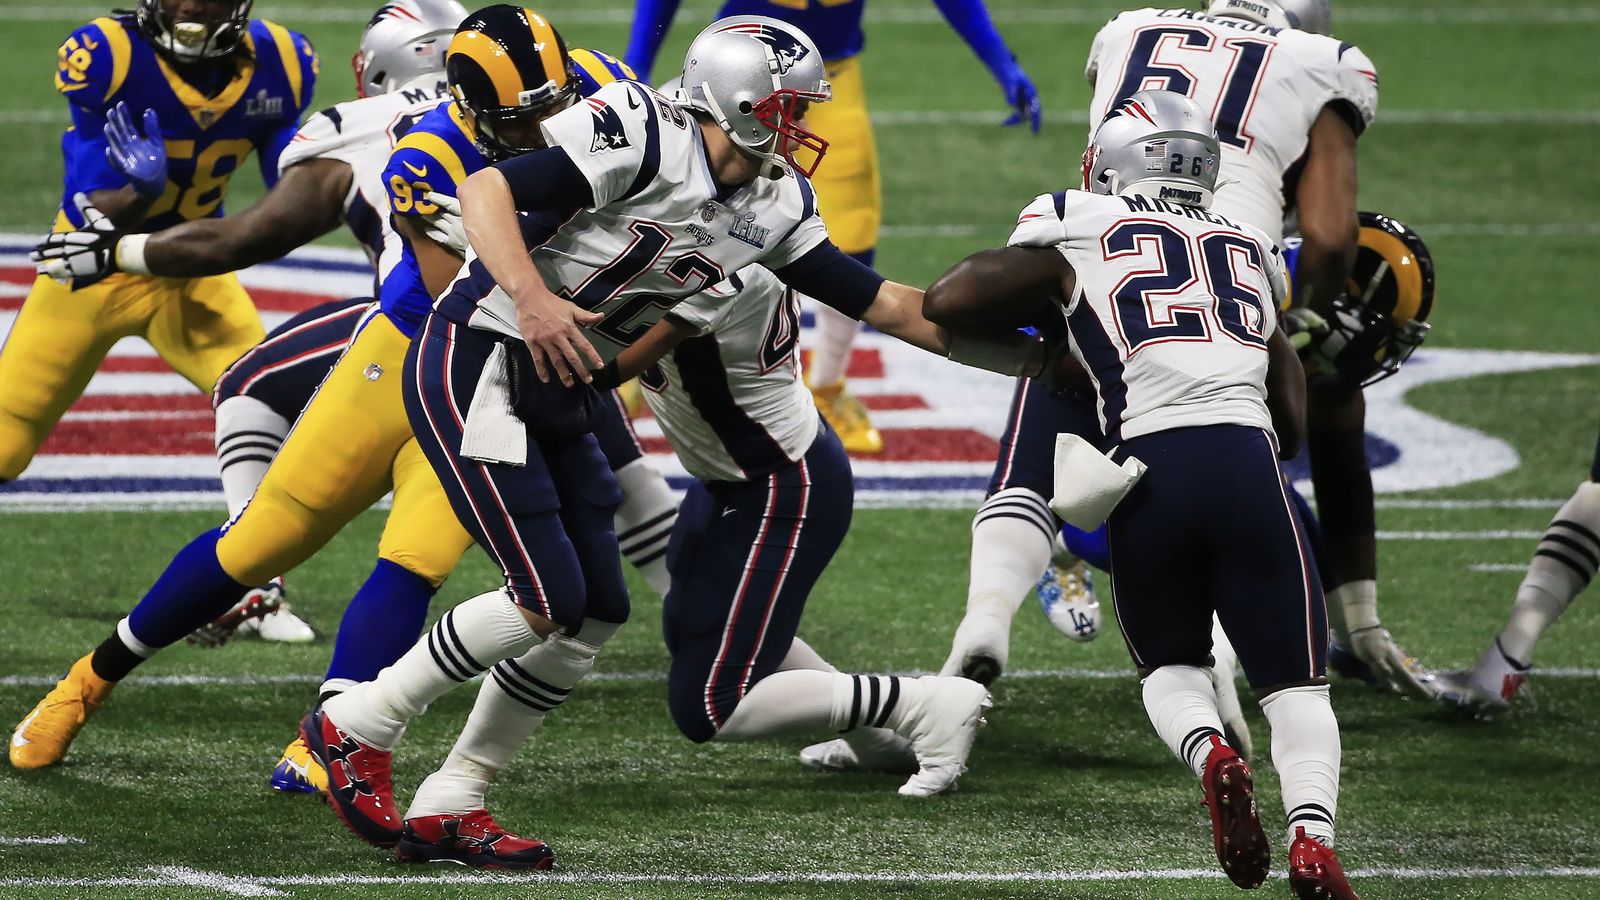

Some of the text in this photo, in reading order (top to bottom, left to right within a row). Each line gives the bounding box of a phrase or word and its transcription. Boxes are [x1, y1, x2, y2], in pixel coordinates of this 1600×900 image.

[1110, 24, 1278, 154] 61
[1170, 153, 1203, 177] 26
[389, 174, 440, 215] 93
[1119, 194, 1242, 231] MICHEL
[1159, 186, 1203, 203] PATRIOTS
[684, 223, 714, 246] PATRIOTS
[556, 220, 725, 347] 12
[1100, 218, 1269, 358] 26
[1067, 607, 1096, 637] LA
